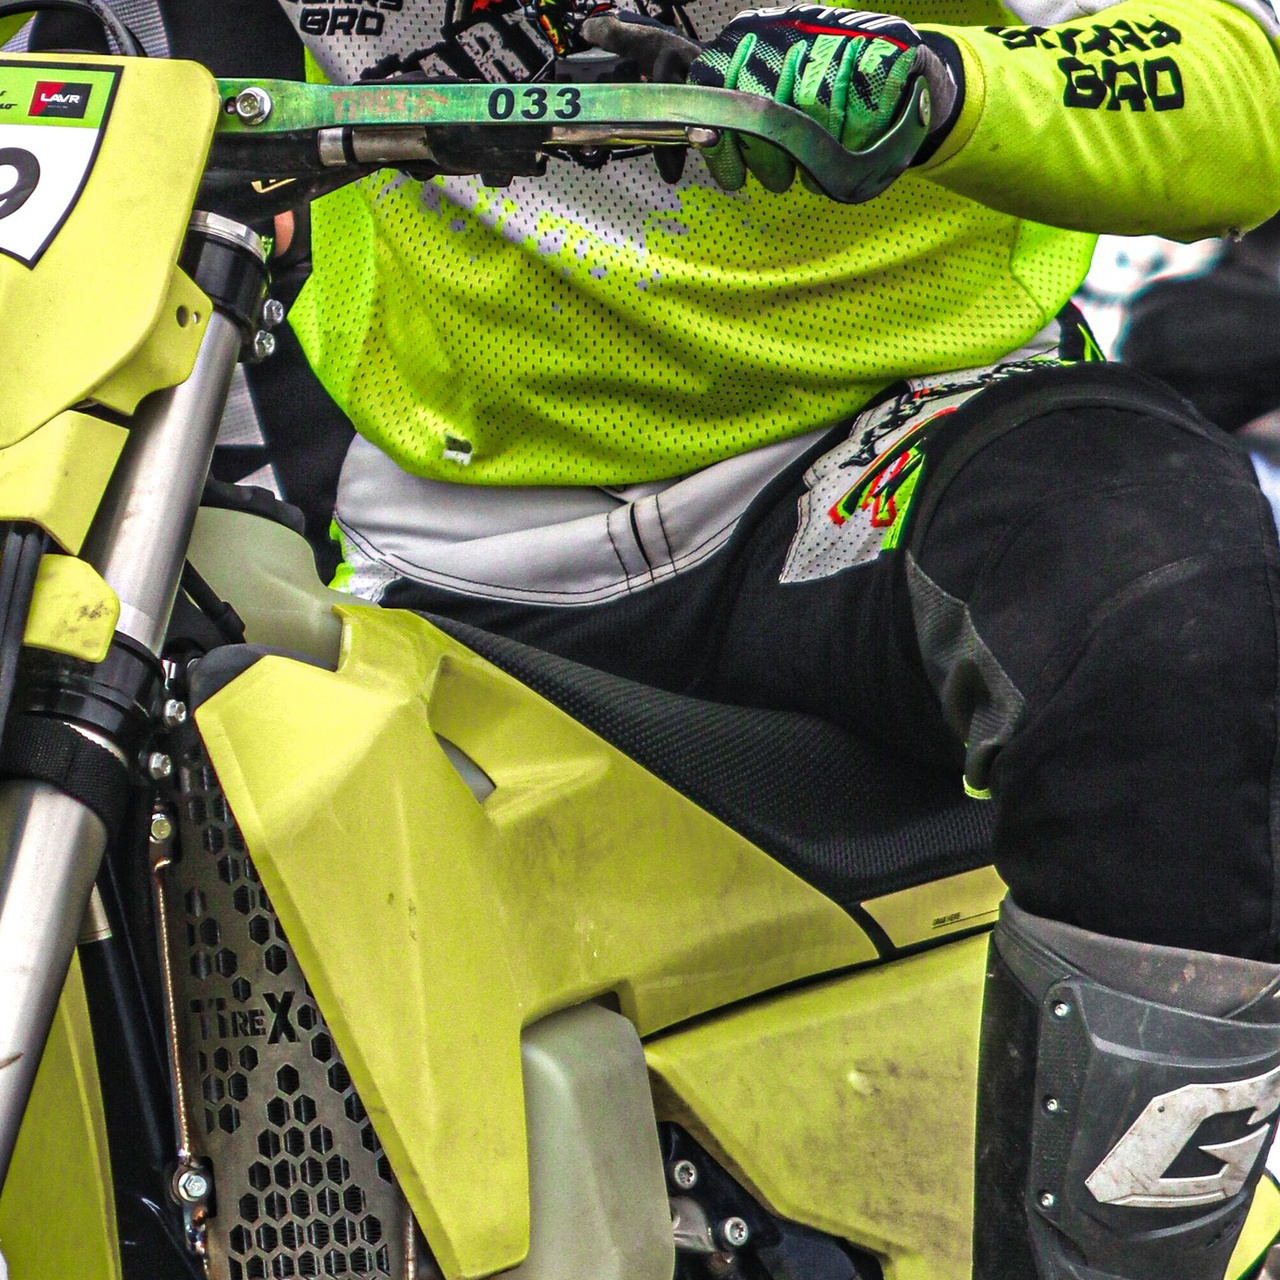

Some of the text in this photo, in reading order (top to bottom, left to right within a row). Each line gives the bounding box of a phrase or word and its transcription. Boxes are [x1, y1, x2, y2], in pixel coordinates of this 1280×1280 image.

[299, 7, 385, 36] BRO
[40, 93, 81, 103] LAVR
[1057, 56, 1185, 111] BRO
[488, 87, 581, 120] 033
